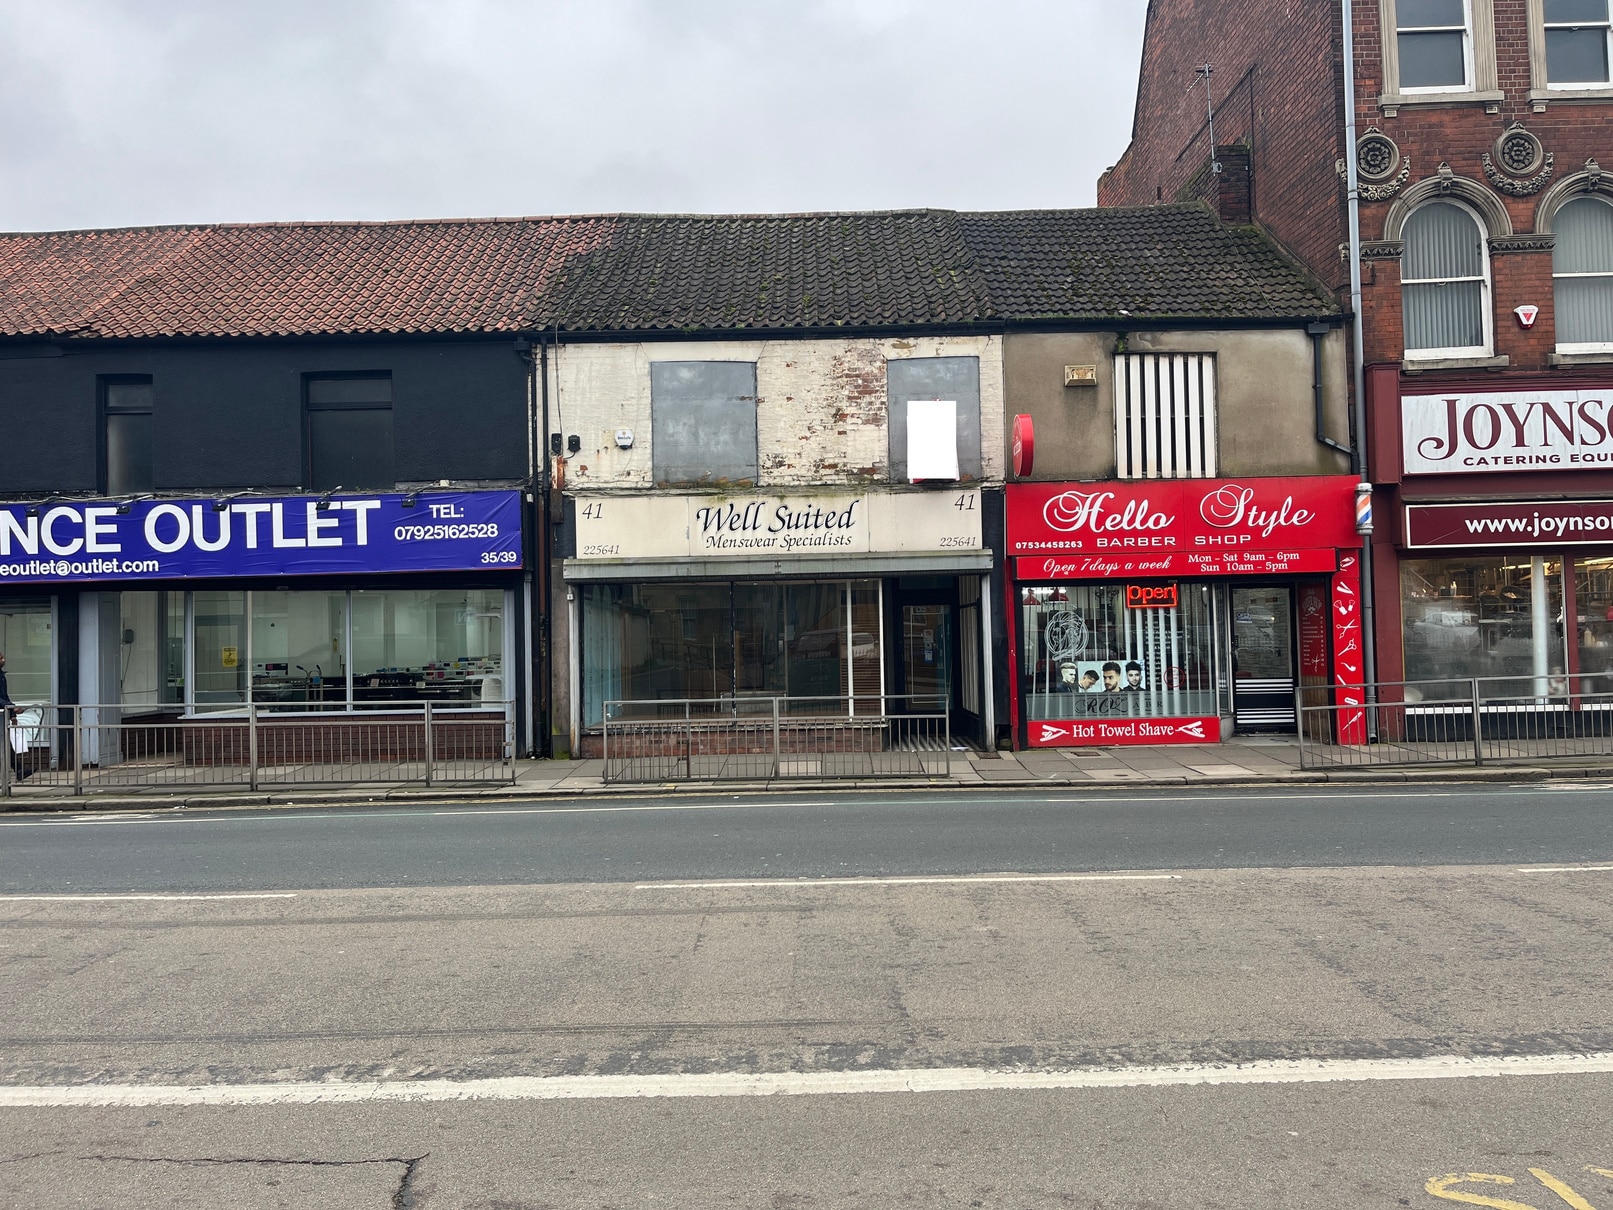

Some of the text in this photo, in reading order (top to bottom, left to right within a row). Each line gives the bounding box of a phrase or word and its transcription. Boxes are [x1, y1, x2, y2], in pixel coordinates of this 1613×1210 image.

[1417, 399, 1613, 461] JOYNS
[1463, 454, 1561, 466] CATERING
[954, 494, 976, 511] 41
[429, 503, 464, 519] TEL:
[582, 503, 603, 519] 41
[696, 500, 860, 533] Well Suited
[1043, 484, 1316, 538] Hello Style
[0, 500, 381, 556] NCE OUTLET
[394, 523, 499, 541] 07925162528
[1464, 511, 1613, 538] www.joynso
[705, 532, 852, 551] Menswear Specialists
[939, 536, 976, 547] 225641
[1015, 540, 1083, 549] 07534458263
[1096, 534, 1251, 547] BARBER SHOP
[481, 551, 517, 563] 35/39
[583, 544, 620, 555] 225641
[1188, 554, 1212, 563] Mon
[1223, 553, 1238, 562] Sat
[1243, 553, 1266, 561] 9am
[1276, 551, 1300, 561] 6pm
[0, 558, 159, 576] eoutlet@outlet.com
[1043, 555, 1173, 578] Open 7days a week
[1200, 563, 1220, 572] Sun
[1226, 562, 1254, 571] 10am
[1265, 562, 1289, 572] 5pm
[1130, 585, 1175, 604] Open
[1072, 722, 1175, 738] Hot Towel Shave
